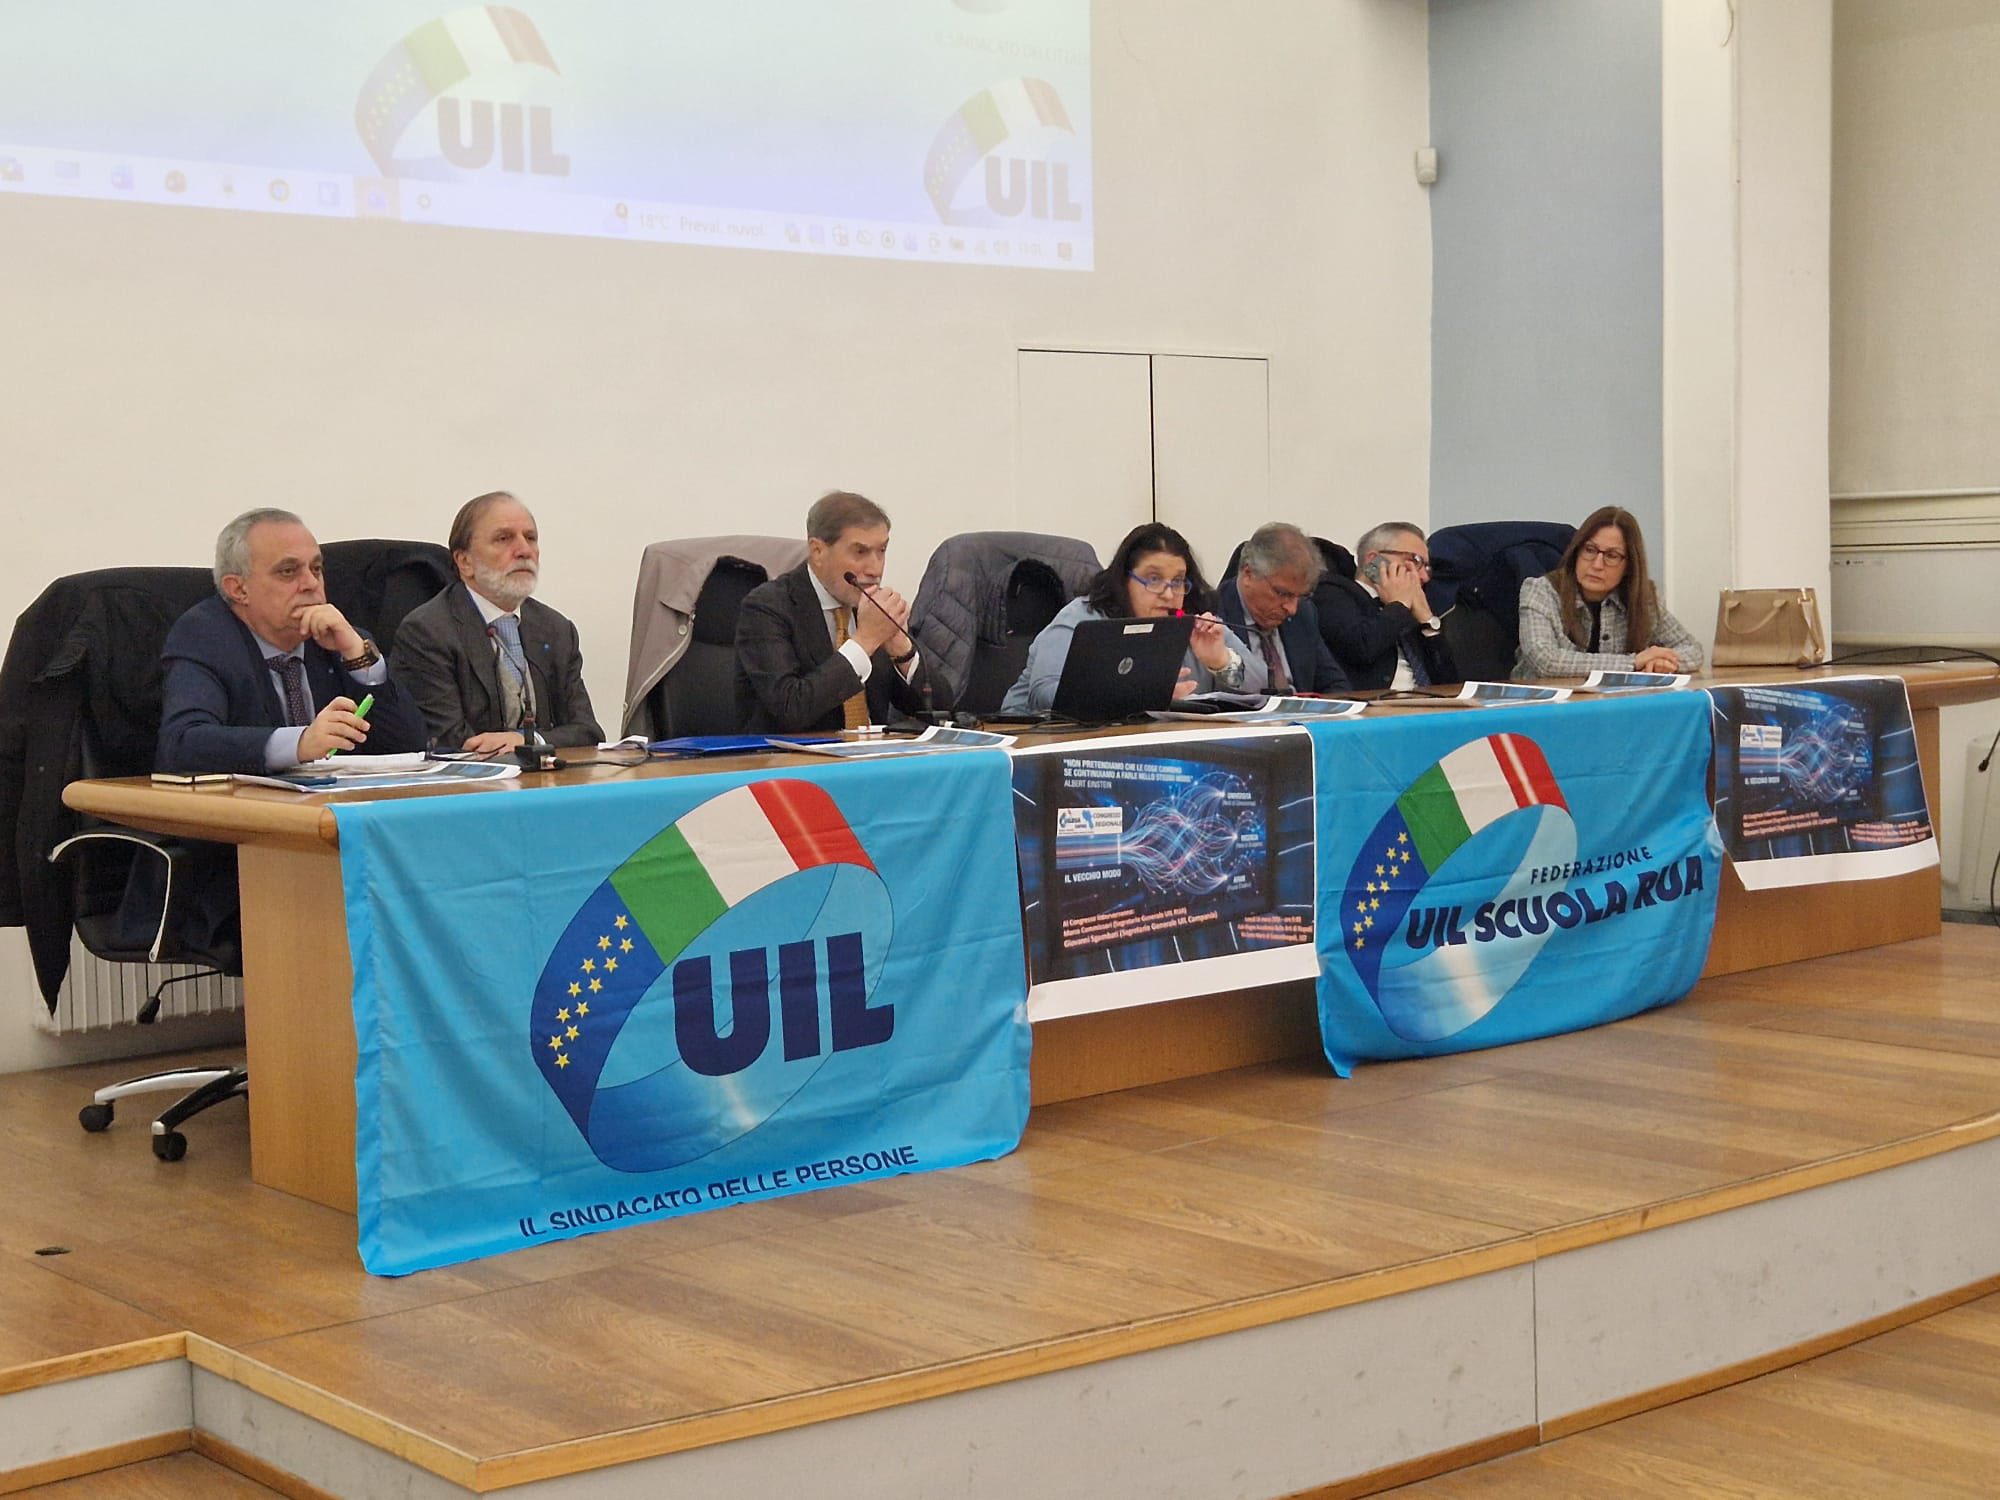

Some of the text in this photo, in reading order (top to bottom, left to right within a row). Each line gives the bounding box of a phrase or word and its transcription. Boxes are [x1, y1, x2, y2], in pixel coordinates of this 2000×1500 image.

[437, 97, 571, 177] UIL
[985, 154, 1083, 222] UIL
[1406, 855, 1704, 949] UIL SCUOLA RUA
[1530, 847, 1653, 885] FEDERAZIONE
[672, 931, 894, 1076] UIL
[520, 1146, 919, 1238] IL SINDACATO DELLE PERSONE
